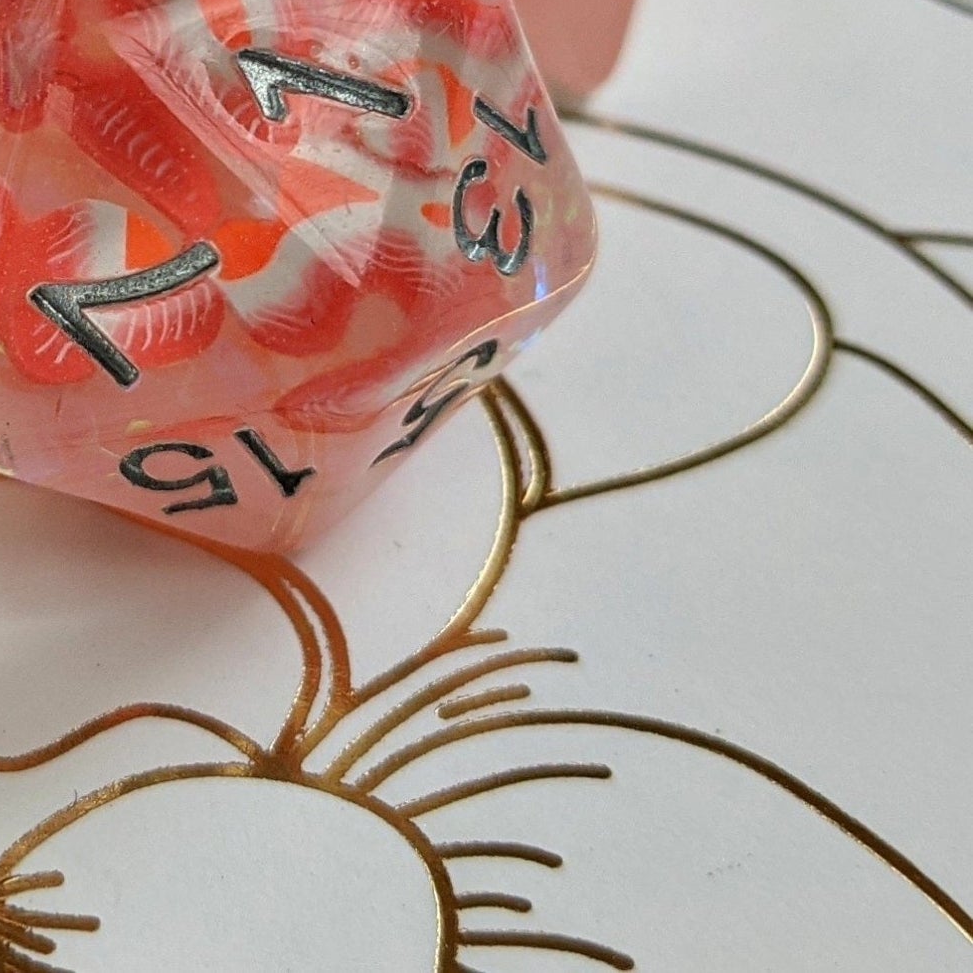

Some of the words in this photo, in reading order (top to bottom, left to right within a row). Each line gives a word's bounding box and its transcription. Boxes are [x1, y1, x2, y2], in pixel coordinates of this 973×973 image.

[235, 48, 413, 123] 1
[451, 94, 549, 278] 13
[28, 241, 219, 388] 7
[118, 428, 316, 515] 15
